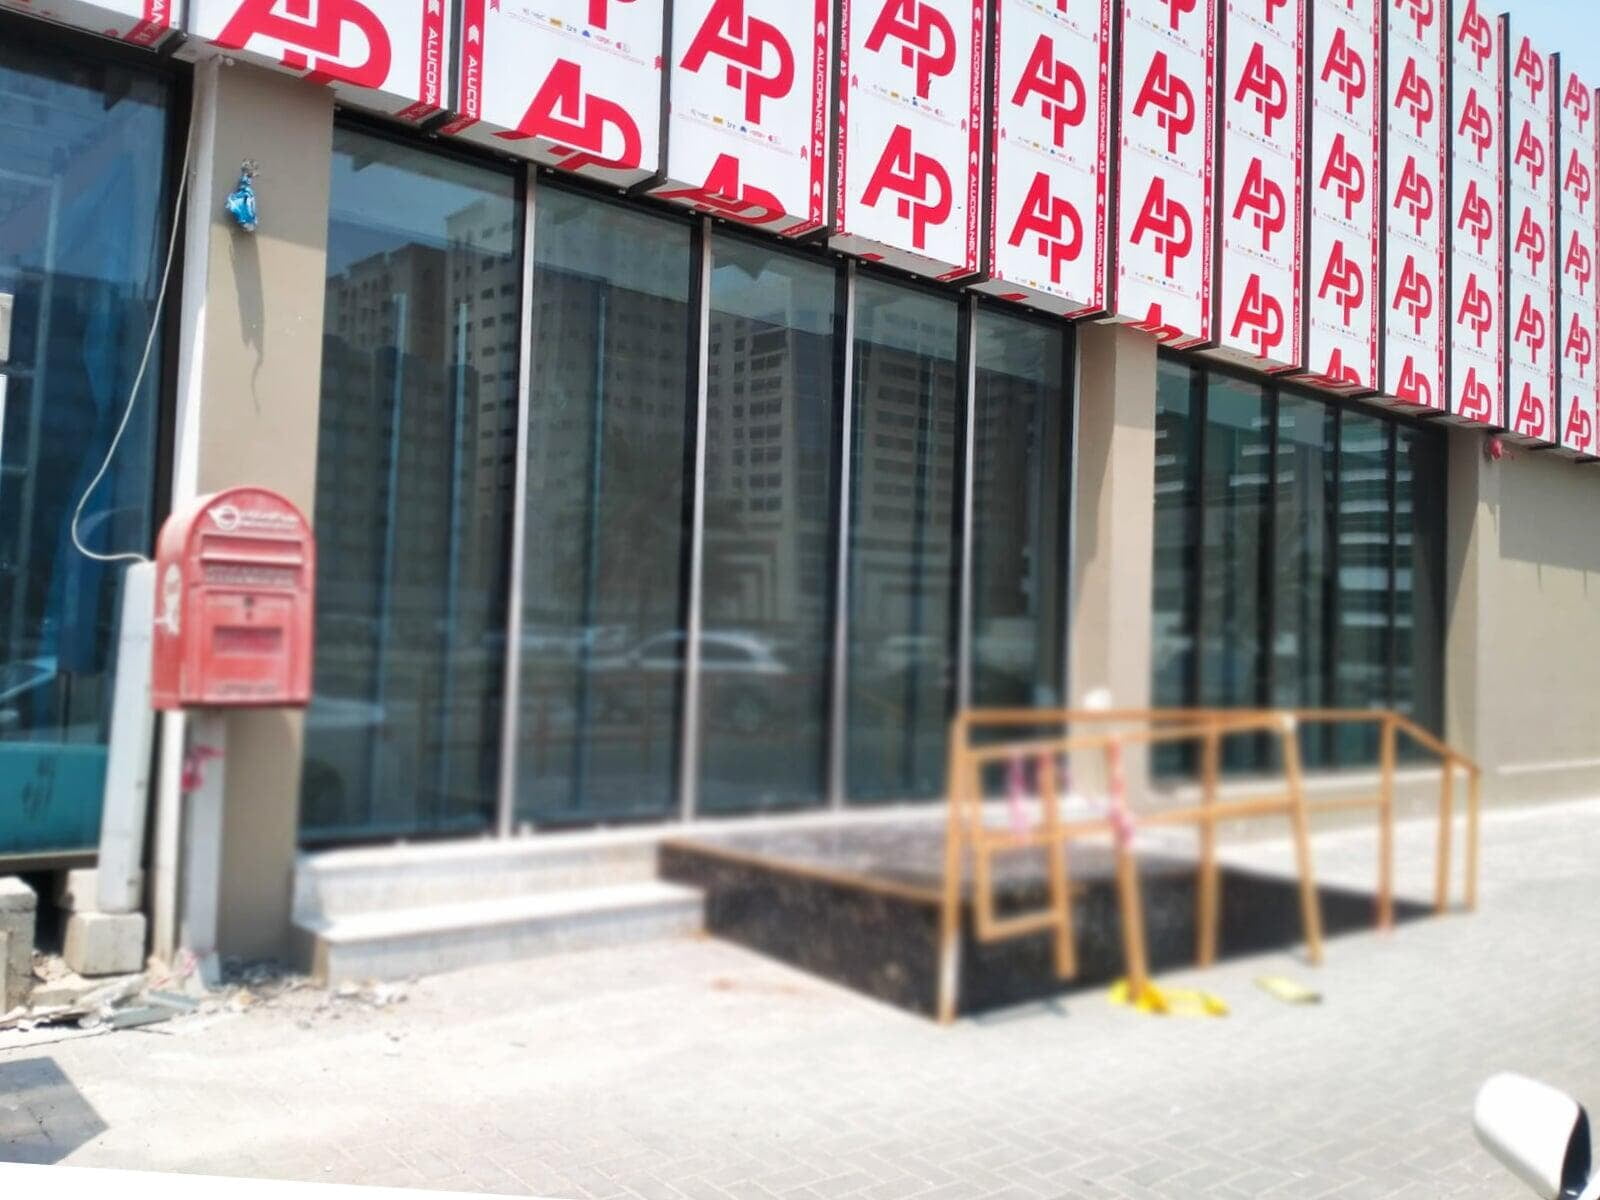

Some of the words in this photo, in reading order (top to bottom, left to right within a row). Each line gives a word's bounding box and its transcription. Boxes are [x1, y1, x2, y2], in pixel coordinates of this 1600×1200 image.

[680, 0, 795, 125] AP
[864, 0, 957, 100] AP
[1011, 34, 1087, 148] AP
[1234, 42, 1288, 137] AP
[1320, 27, 1366, 115] AP
[1132, 50, 1196, 154] AP
[1394, 56, 1434, 138] AP
[1457, 87, 1493, 163] AP
[860, 124, 953, 250] AP
[1232, 157, 1287, 252] AP
[1319, 133, 1365, 220] AP
[1393, 155, 1434, 237] AP
[1457, 179, 1493, 255] AP
[1007, 171, 1084, 284] AP
[1129, 176, 1193, 279] AP
[1317, 239, 1364, 326] AP
[1392, 254, 1433, 335] AP
[1457, 273, 1493, 347] AP
